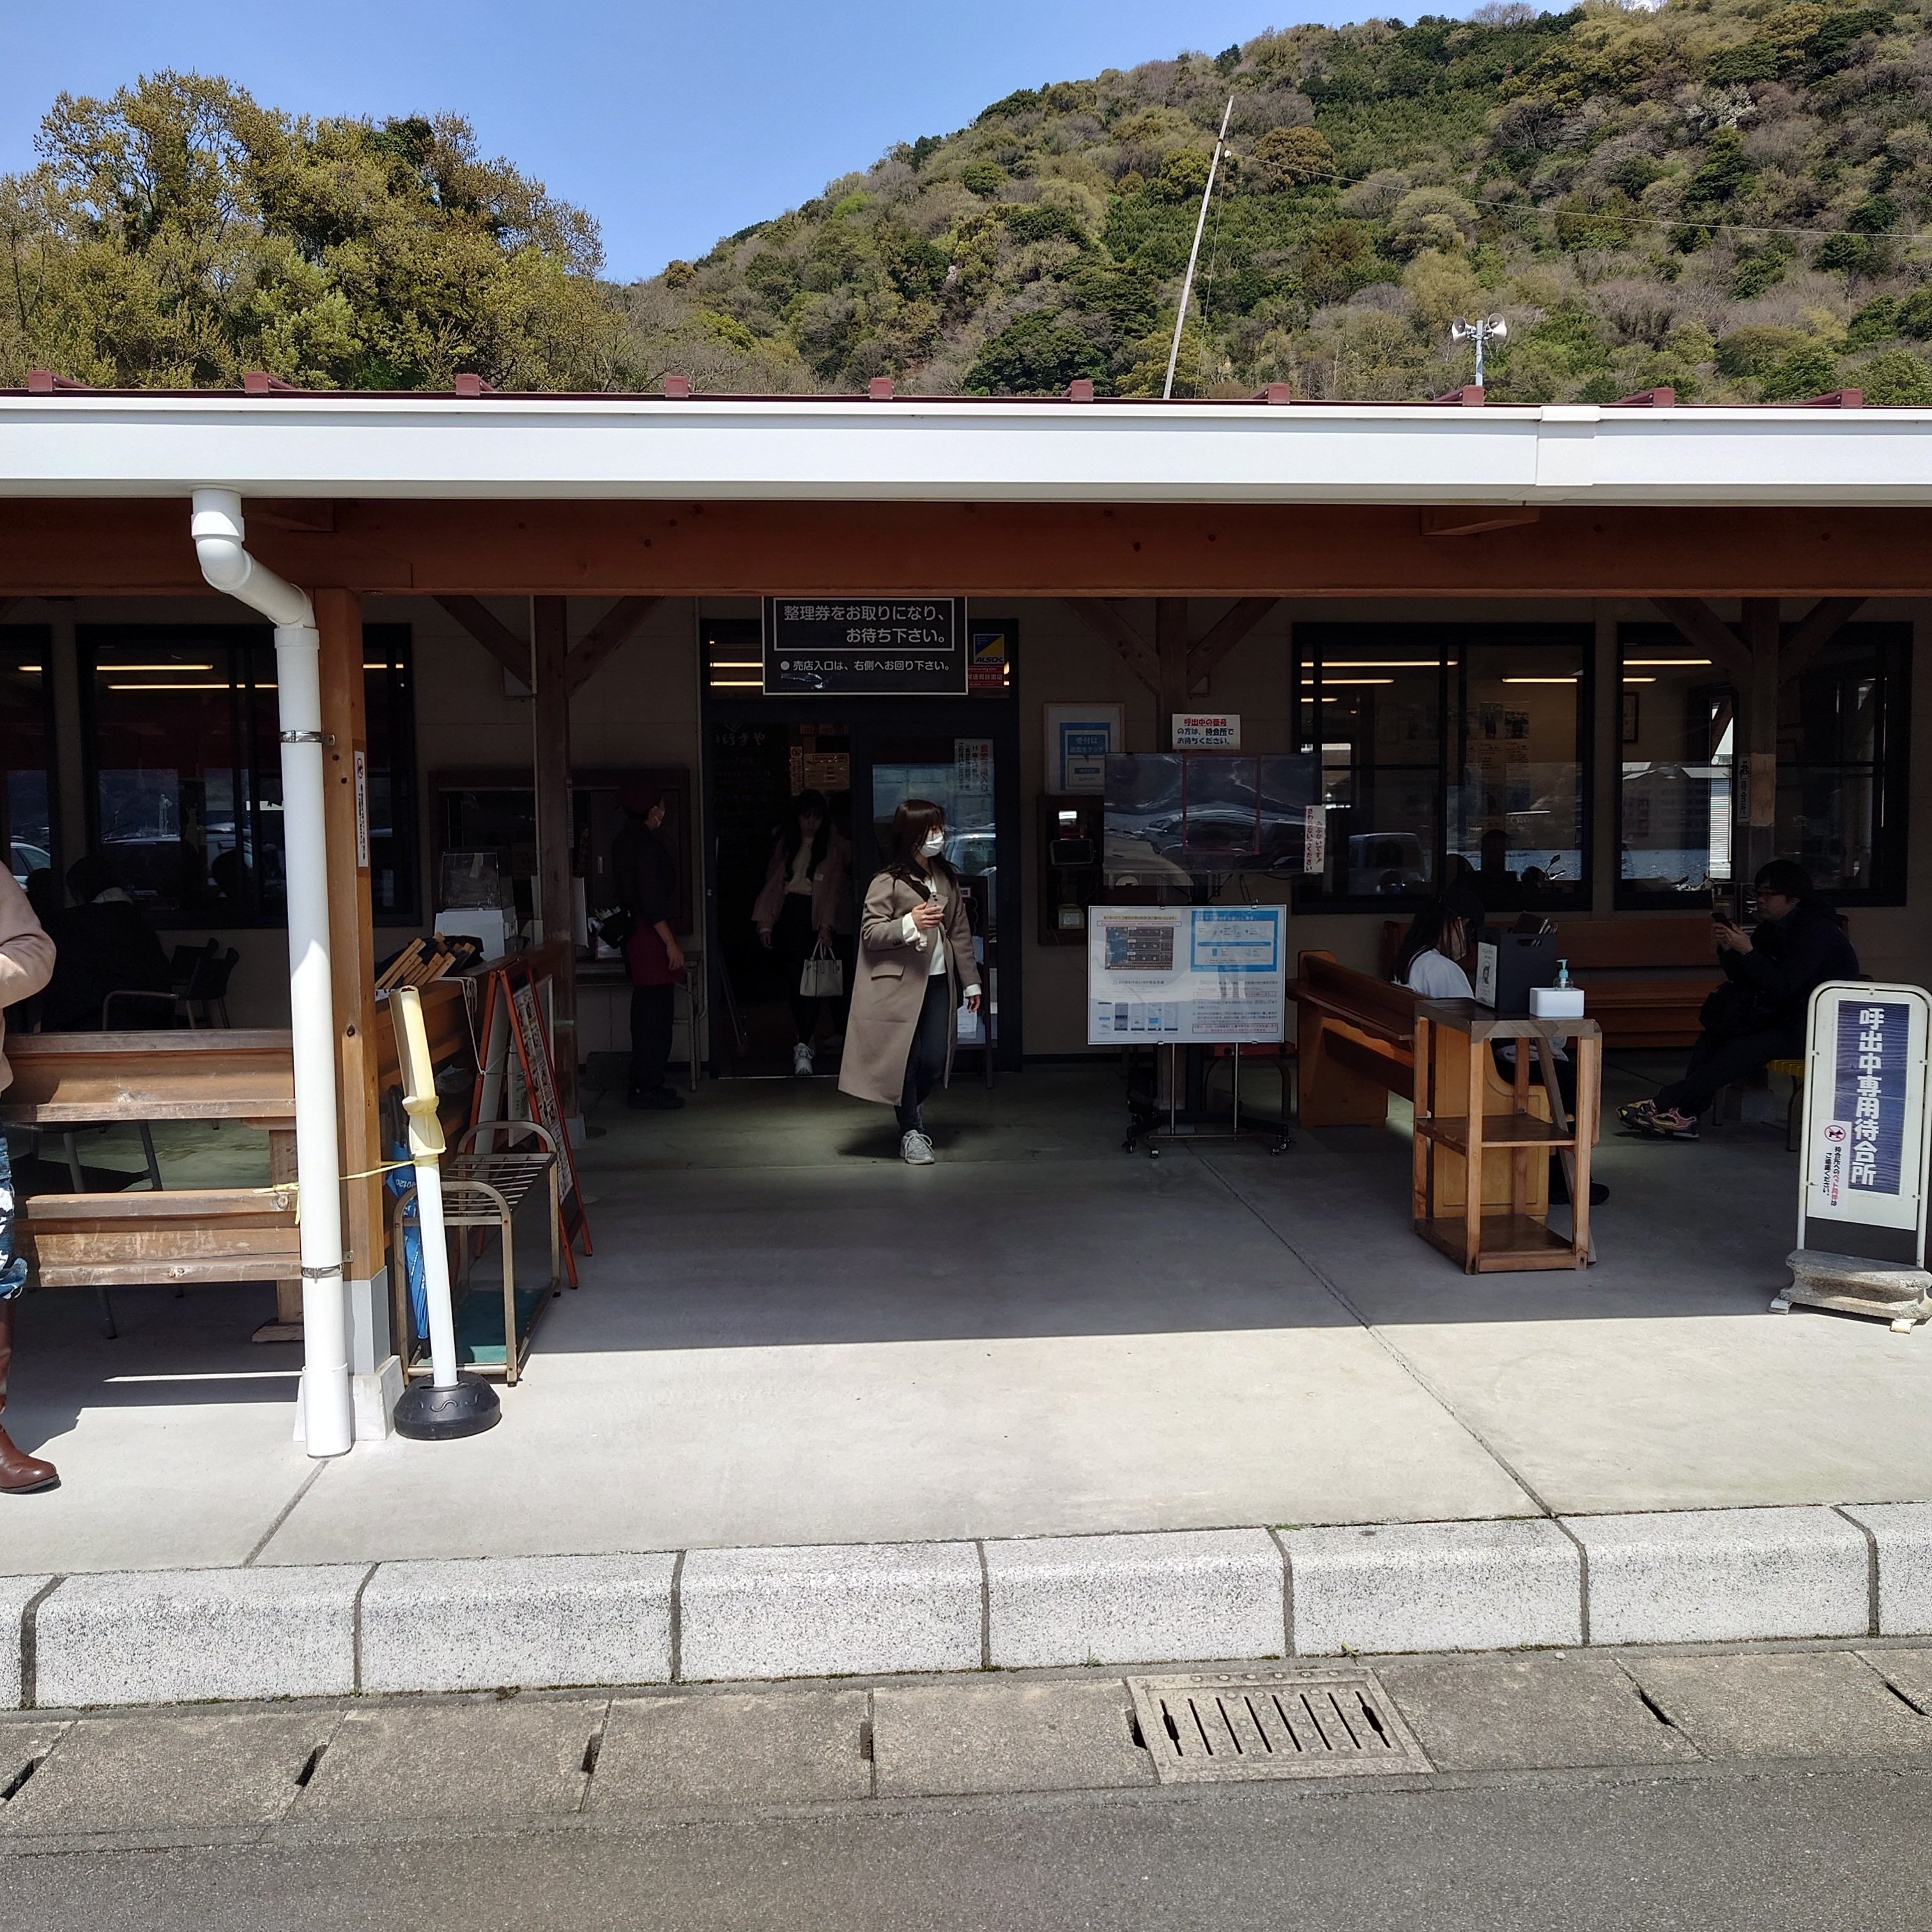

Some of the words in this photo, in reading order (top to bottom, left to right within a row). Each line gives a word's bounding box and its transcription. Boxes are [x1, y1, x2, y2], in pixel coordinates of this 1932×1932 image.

[784, 605, 944, 621] 整理券をお取りになり、
[846, 627, 945, 643] お待ち下さい。
[793, 660, 950, 671] 売店入口は、右側へお回り下さい。
[1177, 728, 1234, 736] の方は、待合所で
[1075, 736, 1098, 745] 受付は
[1851, 1008, 1885, 1186] 呼出中専用待合所
[395, 1179, 411, 1188] 0120
